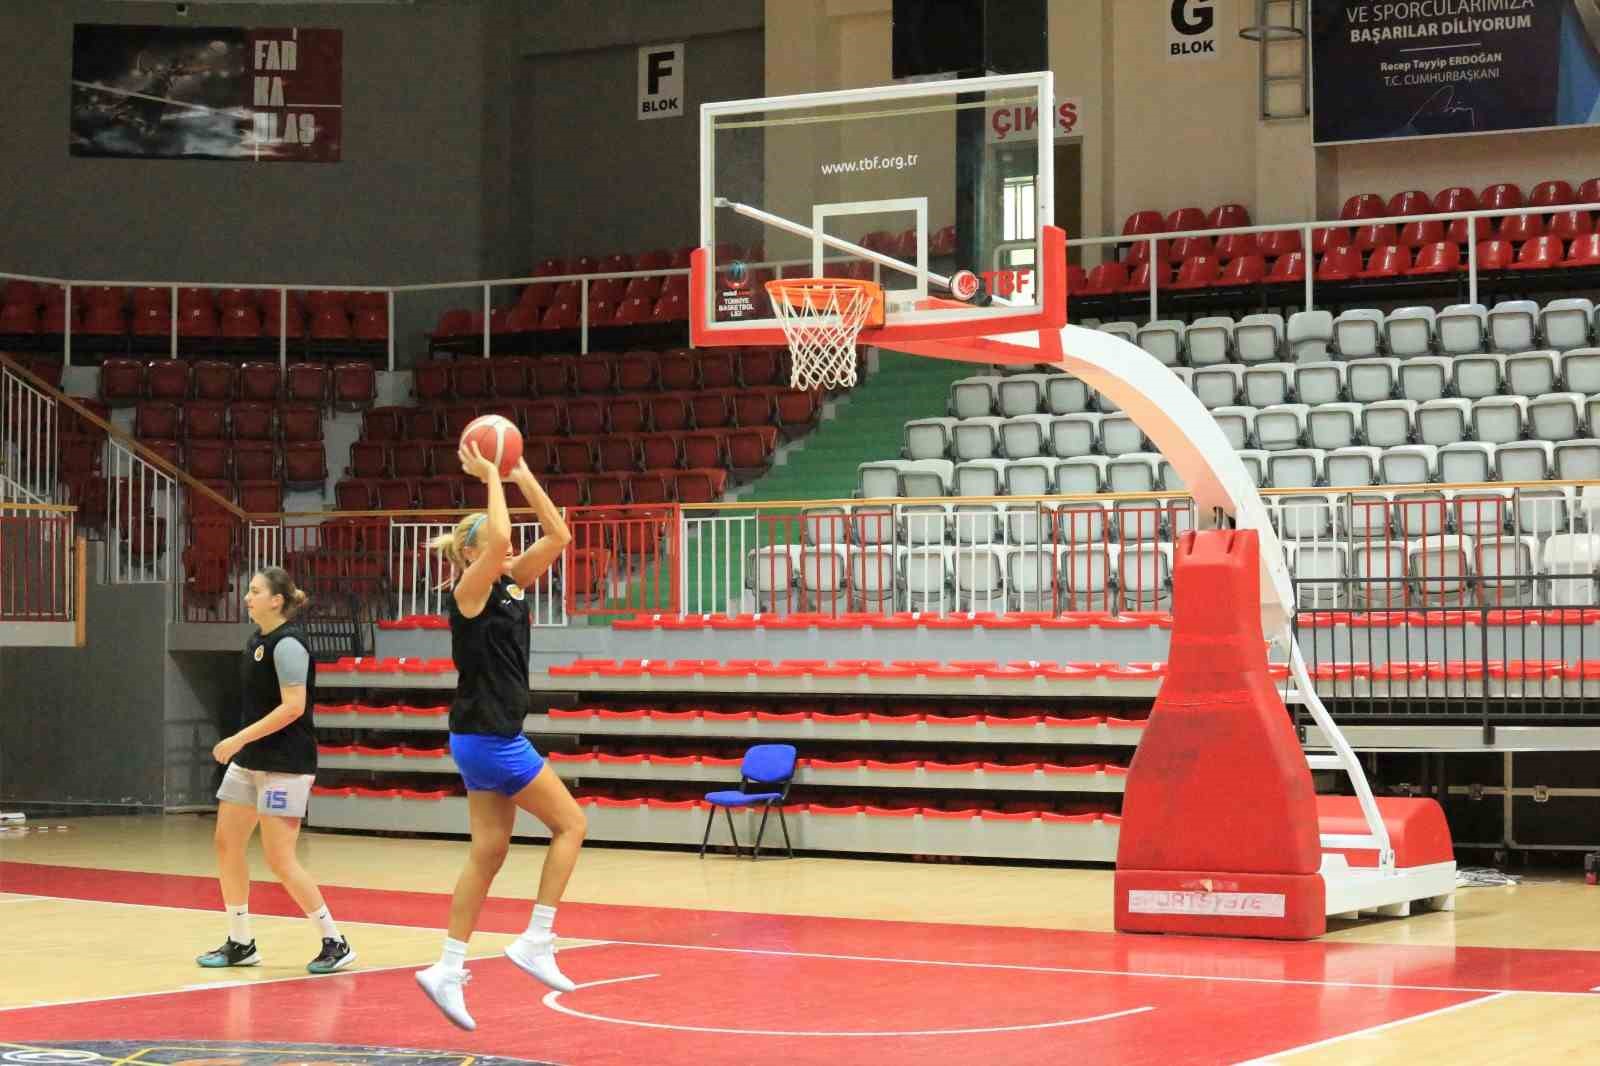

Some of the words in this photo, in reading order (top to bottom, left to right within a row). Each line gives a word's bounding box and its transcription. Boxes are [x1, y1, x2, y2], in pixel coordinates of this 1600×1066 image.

[1171, 0, 1213, 35] G
[1347, 7, 1369, 23] VE
[1350, 23, 1439, 44] BAŞARILAR
[1441, 14, 1532, 35] DİLİYORUM
[1170, 40, 1214, 55] BLOK
[647, 50, 675, 95] F
[1380, 61, 1411, 73] Recep
[1413, 58, 1448, 71] Tayyip
[1449, 52, 1502, 66] ERDOĞAN
[1384, 74, 1402, 87] T.C.
[1404, 67, 1500, 85] CUMHURBAŞKANI
[641, 97, 679, 113] BLOK
[992, 103, 1077, 139] ÇIKŞ
[821, 154, 919, 175] www.tbf.org.tr
[982, 268, 1030, 298] TBF
[264, 790, 289, 809] 15
